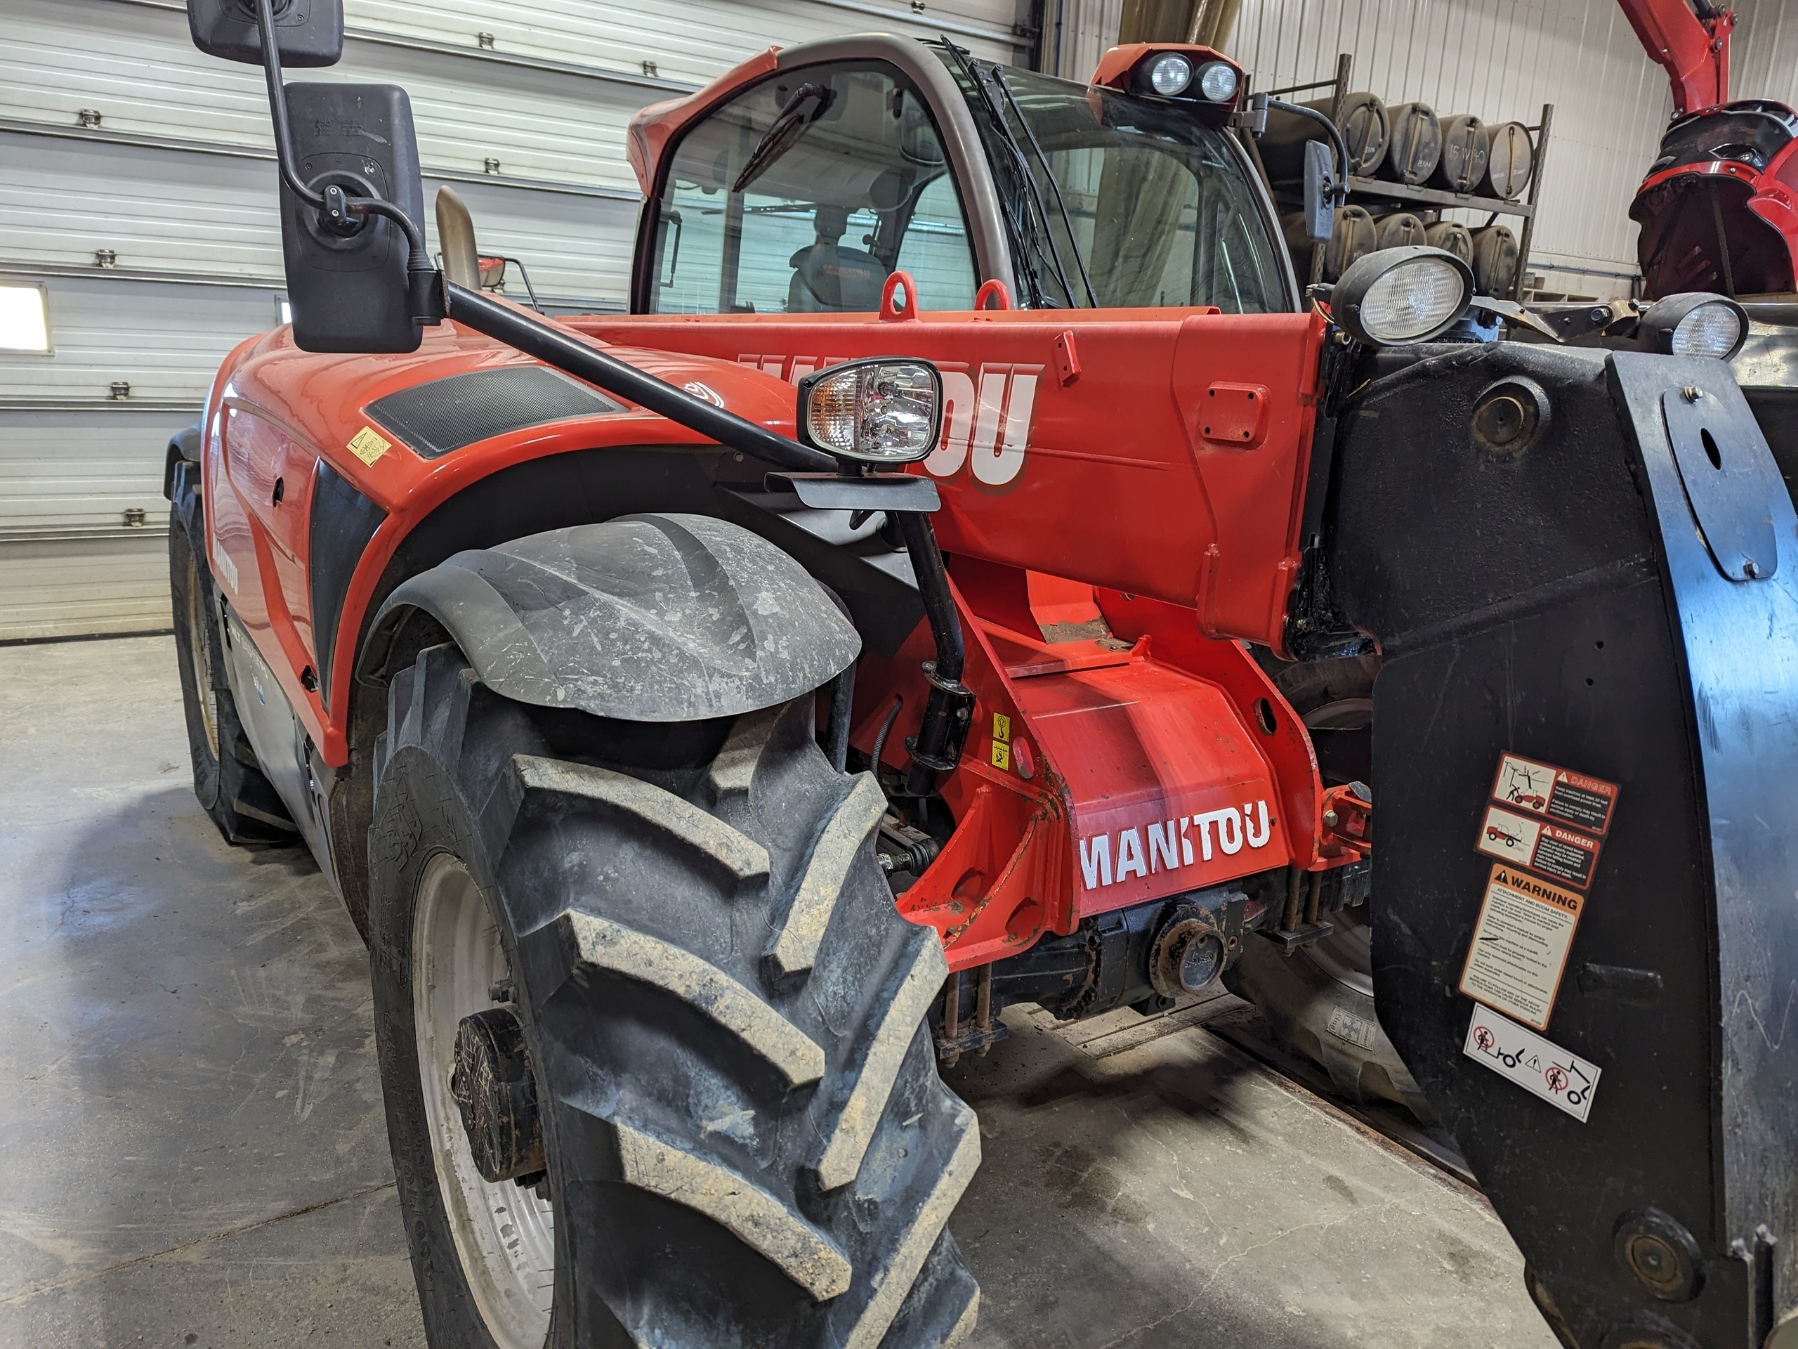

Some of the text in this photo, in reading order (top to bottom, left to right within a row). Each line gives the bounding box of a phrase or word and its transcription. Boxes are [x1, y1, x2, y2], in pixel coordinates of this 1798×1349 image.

[1571, 776, 1612, 795] DANGER
[1079, 799, 1271, 890] MANITOU
[1555, 830, 1594, 849] DANGER
[1510, 876, 1579, 910] WARNING
